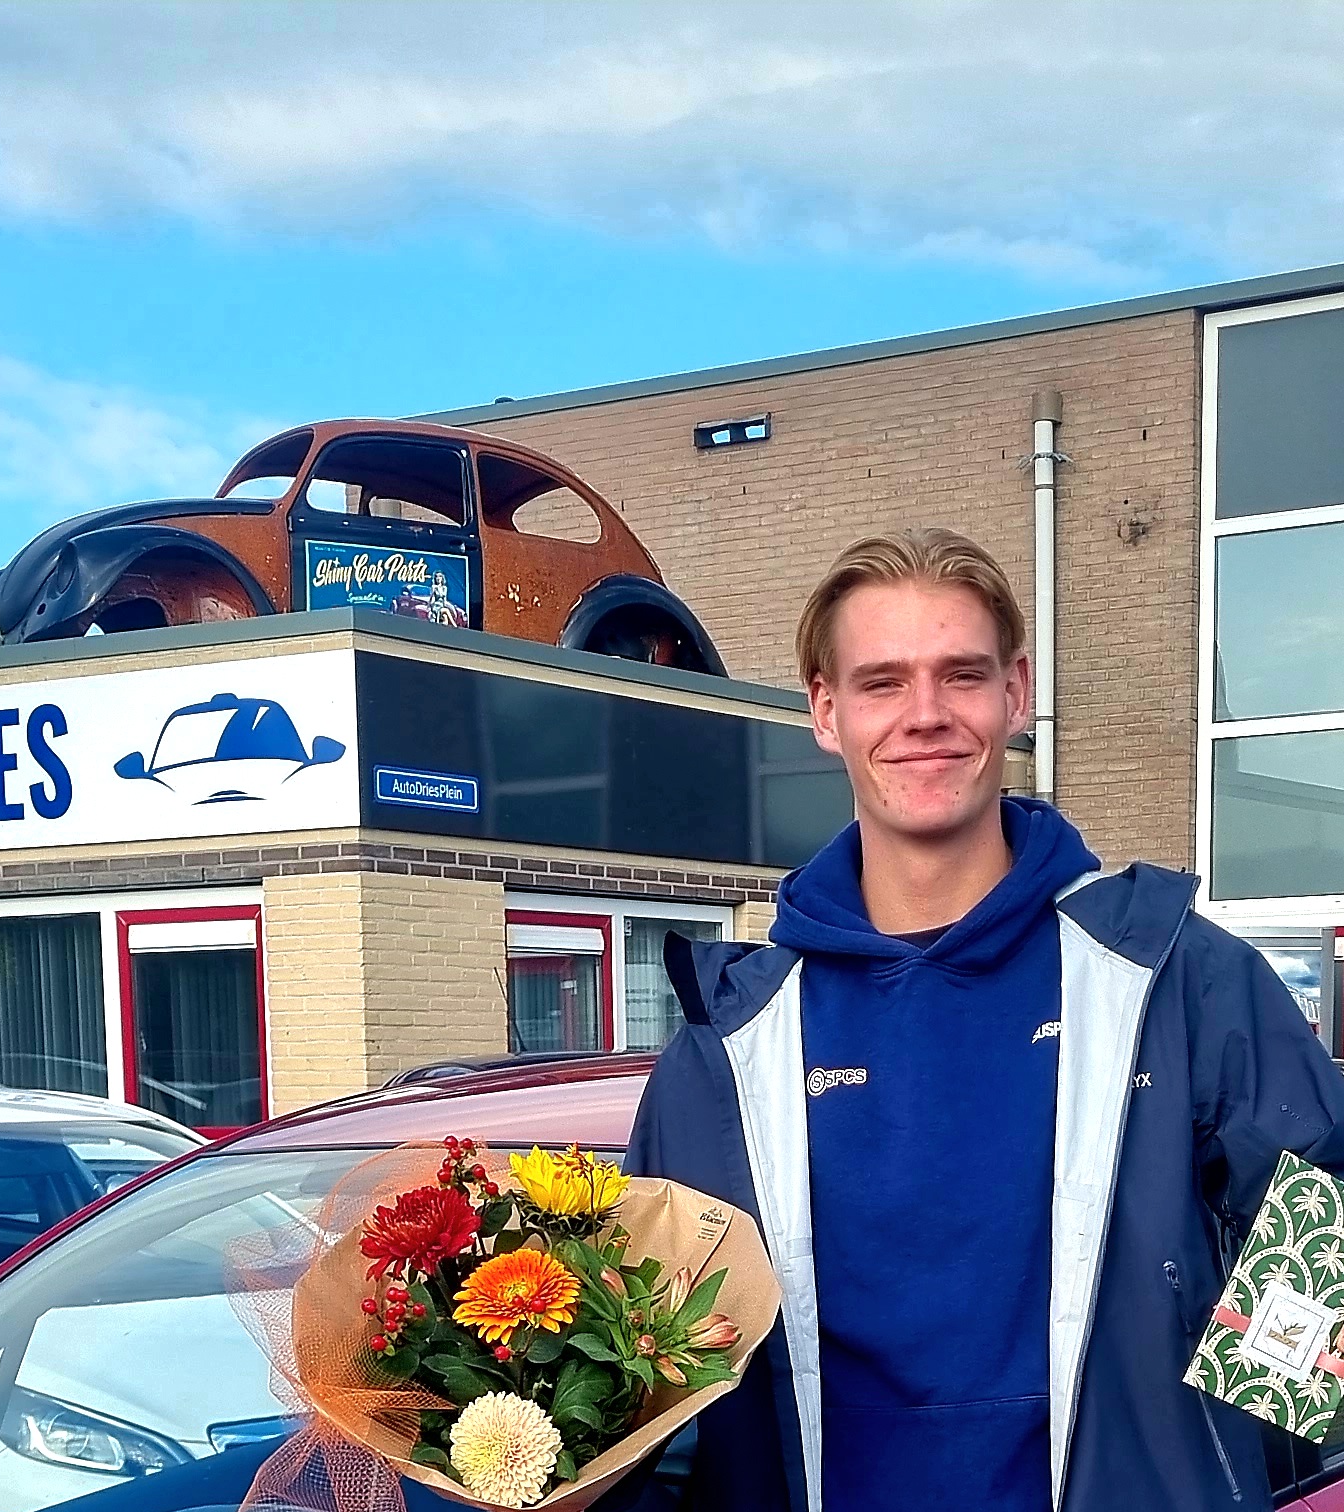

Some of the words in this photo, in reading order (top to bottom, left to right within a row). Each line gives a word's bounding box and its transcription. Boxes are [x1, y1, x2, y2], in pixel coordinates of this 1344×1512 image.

[312, 557, 352, 591] Shiny
[353, 553, 386, 591] Car
[384, 553, 432, 583] Parts
[392, 778, 463, 800] AutoDriesPlein
[1131, 1072, 1152, 1088] YX
